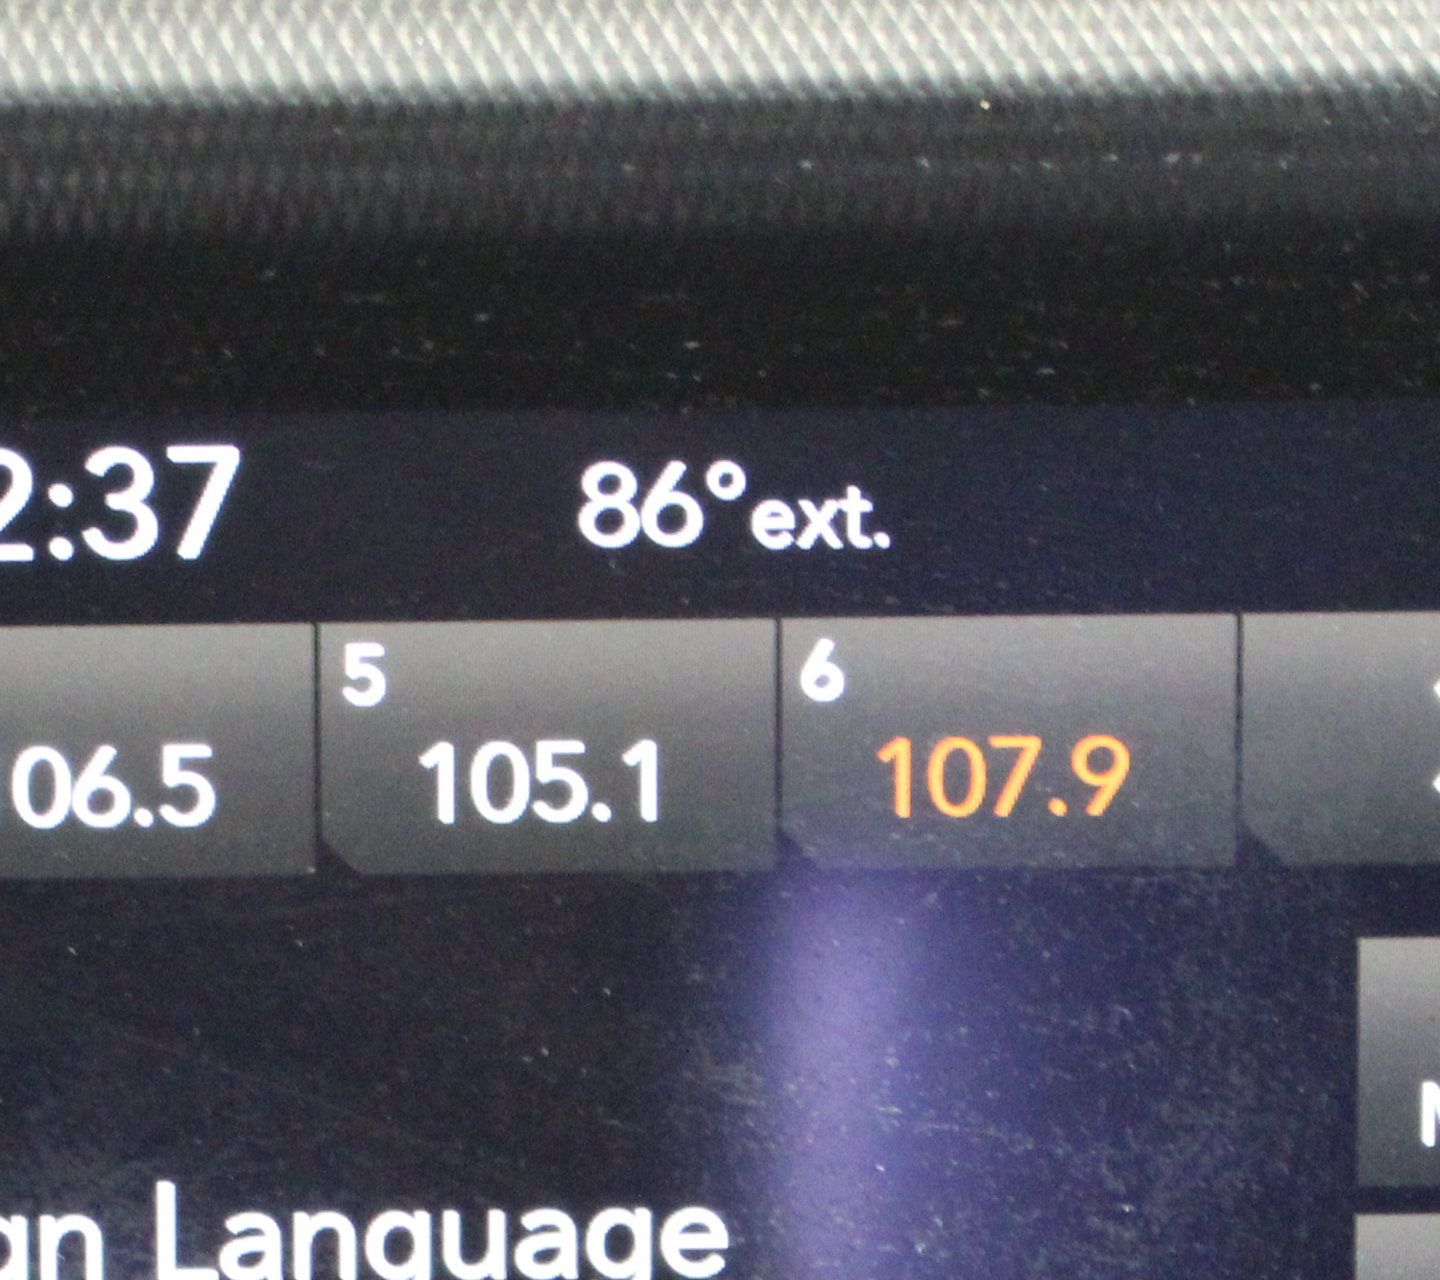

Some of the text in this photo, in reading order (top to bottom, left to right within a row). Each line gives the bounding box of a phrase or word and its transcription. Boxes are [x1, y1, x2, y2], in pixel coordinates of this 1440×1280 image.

[341, 640, 388, 708] 5
[799, 636, 847, 704] 6
[418, 737, 659, 825] 105.1
[877, 733, 1131, 819] 107.9
